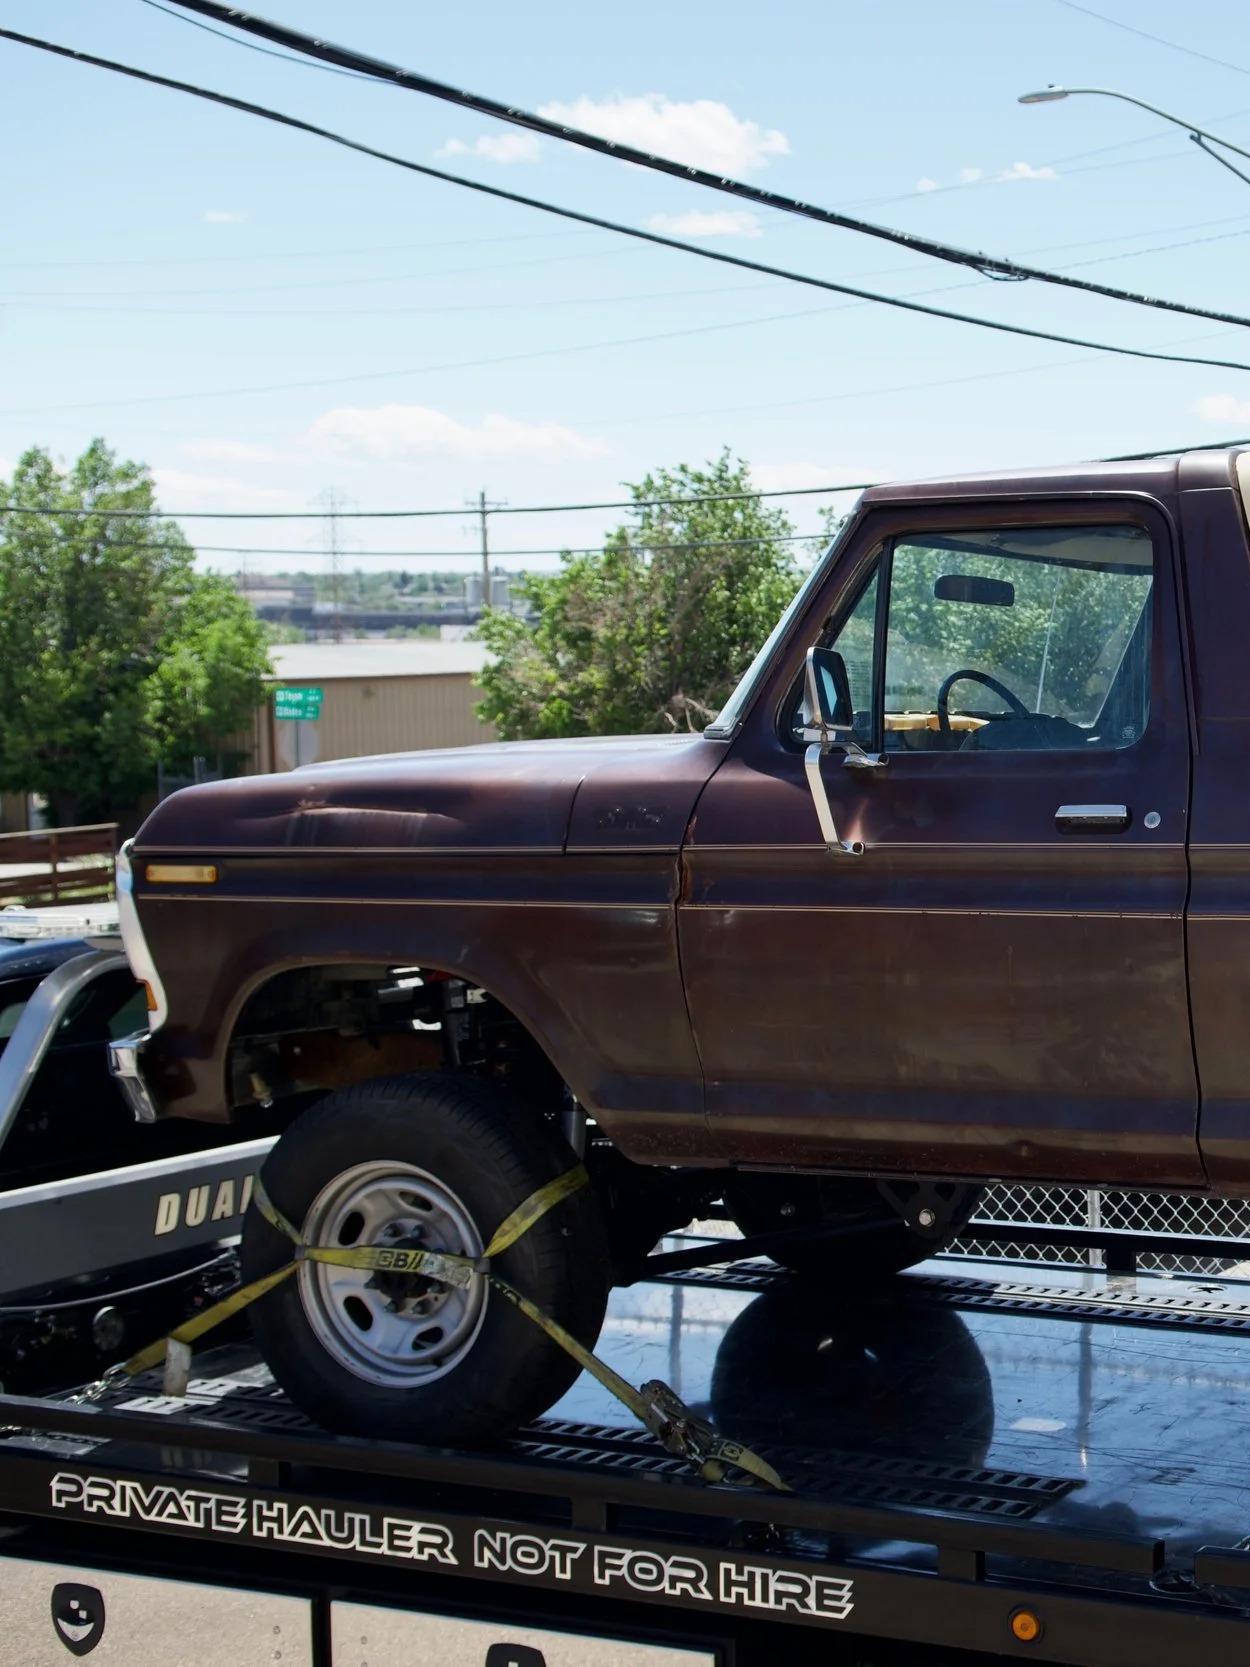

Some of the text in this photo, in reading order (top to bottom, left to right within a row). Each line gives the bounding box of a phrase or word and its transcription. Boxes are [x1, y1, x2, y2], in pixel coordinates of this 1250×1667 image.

[50, 1472, 854, 1619] PRIVATE HAULER NOT FOR HIRE
